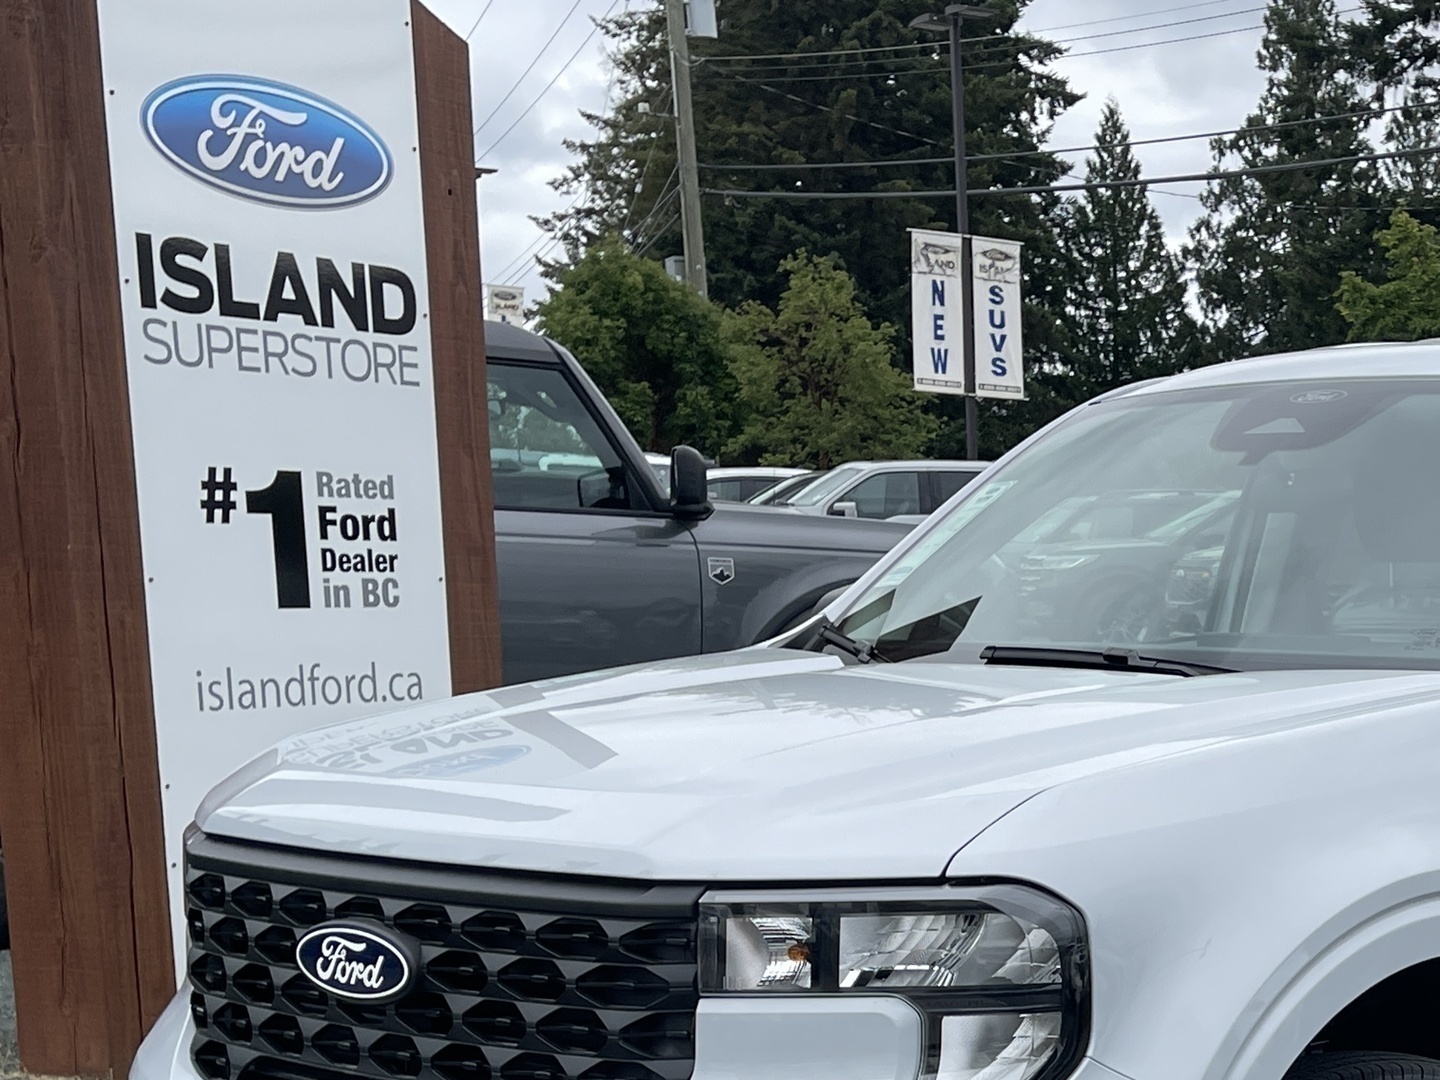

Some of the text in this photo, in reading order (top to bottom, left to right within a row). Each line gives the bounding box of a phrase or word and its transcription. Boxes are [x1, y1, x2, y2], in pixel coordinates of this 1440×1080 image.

[198, 94, 345, 191] Ford
[135, 231, 417, 335] ISLAND
[142, 317, 420, 387] SUPERSTORE
[930, 279, 949, 375] NEW
[988, 284, 1008, 377] SUVS
[316, 470, 394, 500] Rated
[200, 466, 311, 609] #1
[318, 505, 397, 542] Ford
[320, 547, 399, 573] Dealer
[323, 577, 400, 609] in BC
[196, 661, 423, 712] islandford.ca
[315, 935, 385, 990] Ford
